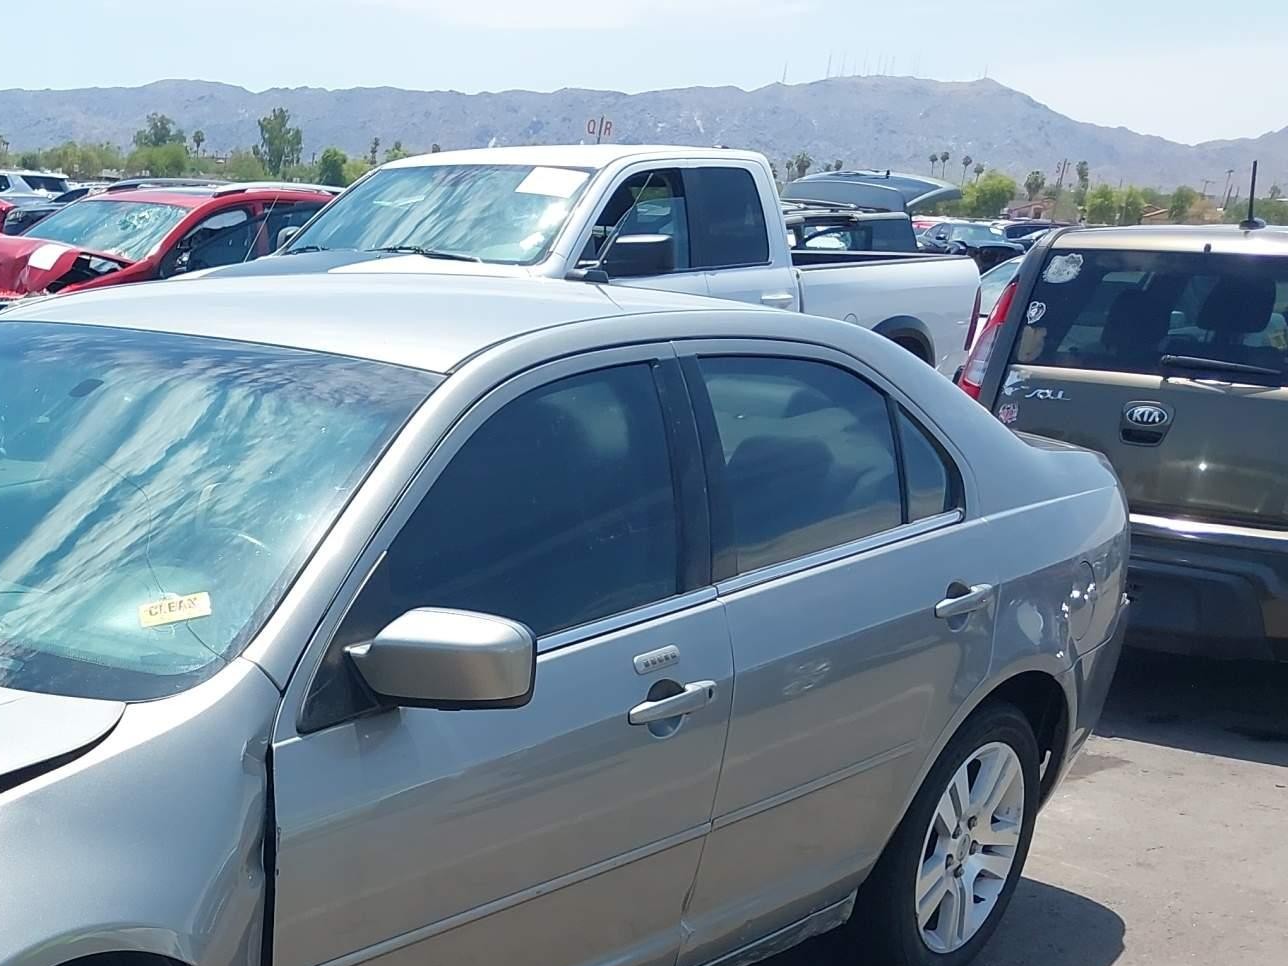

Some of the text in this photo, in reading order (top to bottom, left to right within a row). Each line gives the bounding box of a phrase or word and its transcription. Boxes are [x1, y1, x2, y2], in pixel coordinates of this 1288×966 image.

[587, 119, 613, 136] Q R
[1132, 408, 1160, 423] KIA
